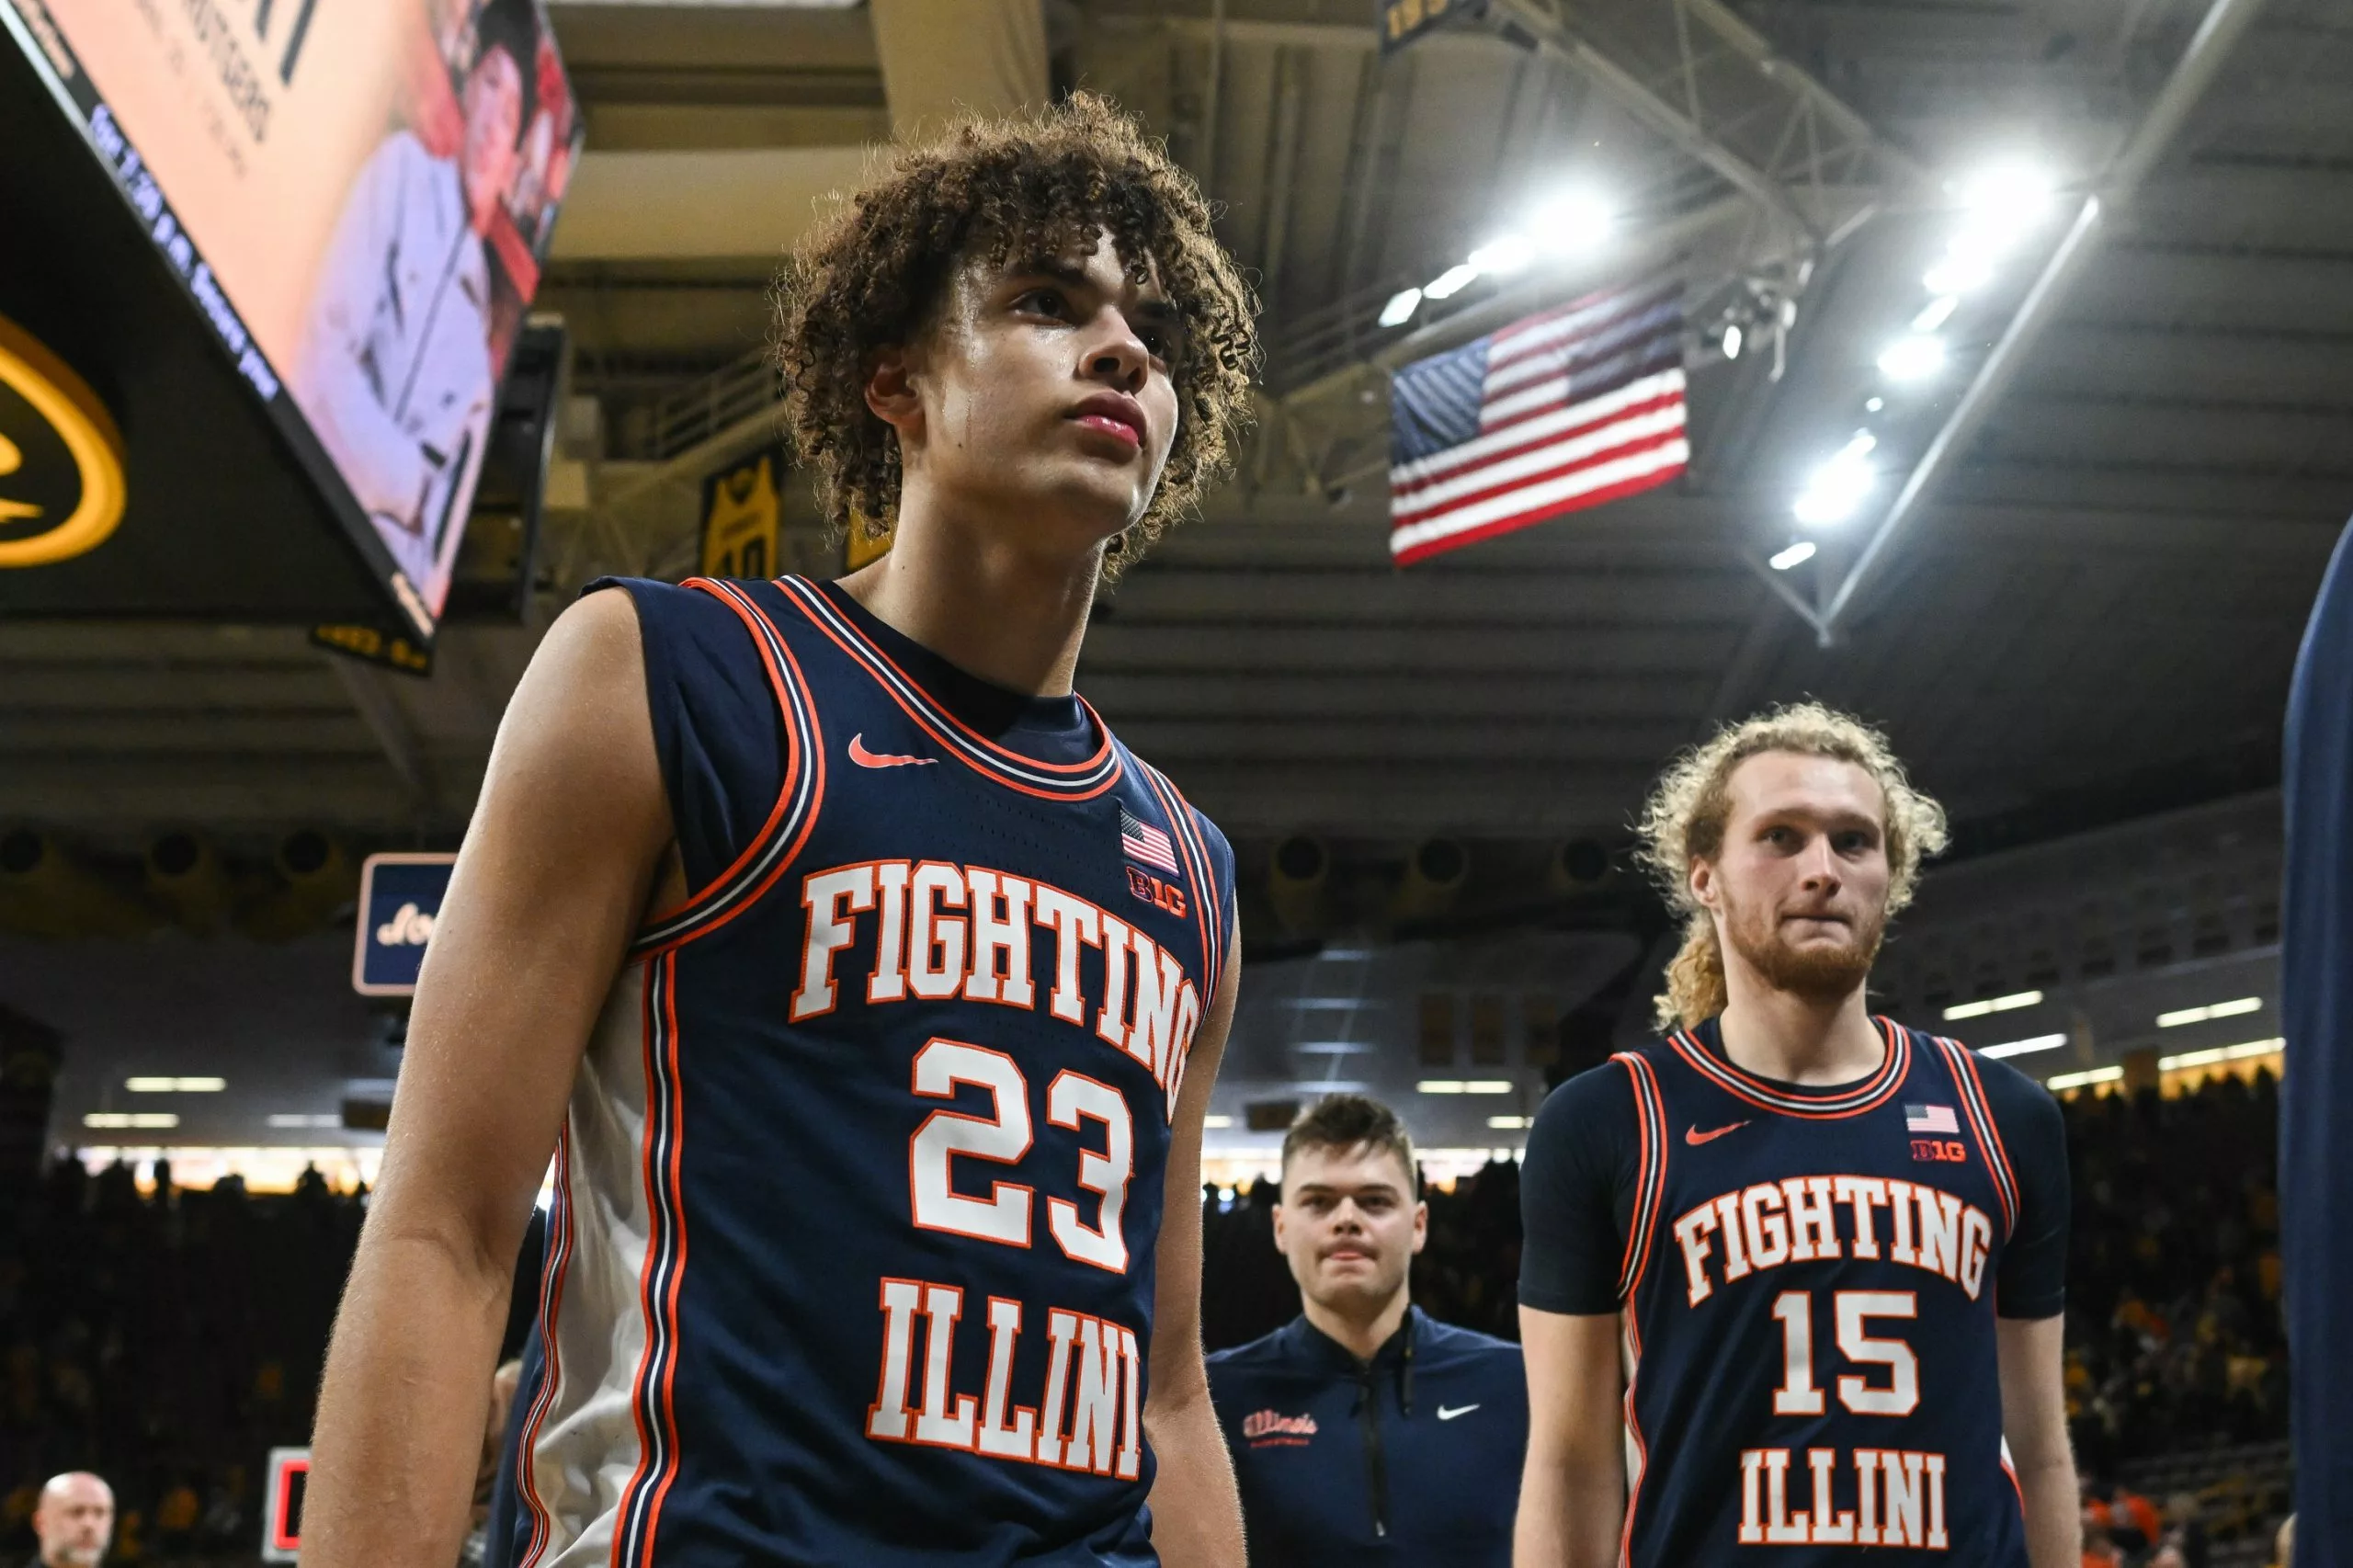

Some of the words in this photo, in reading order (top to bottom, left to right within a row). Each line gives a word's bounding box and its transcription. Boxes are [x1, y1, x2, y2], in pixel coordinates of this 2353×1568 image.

[788, 858, 1200, 1126] FIGHTING
[909, 1037, 1135, 1275] 23
[1673, 1175, 1992, 1309] FIGHTING
[865, 1277, 1141, 1482] ILLINI
[1772, 1290, 1919, 1415] 15
[1738, 1448, 1948, 1550] ILLINI
